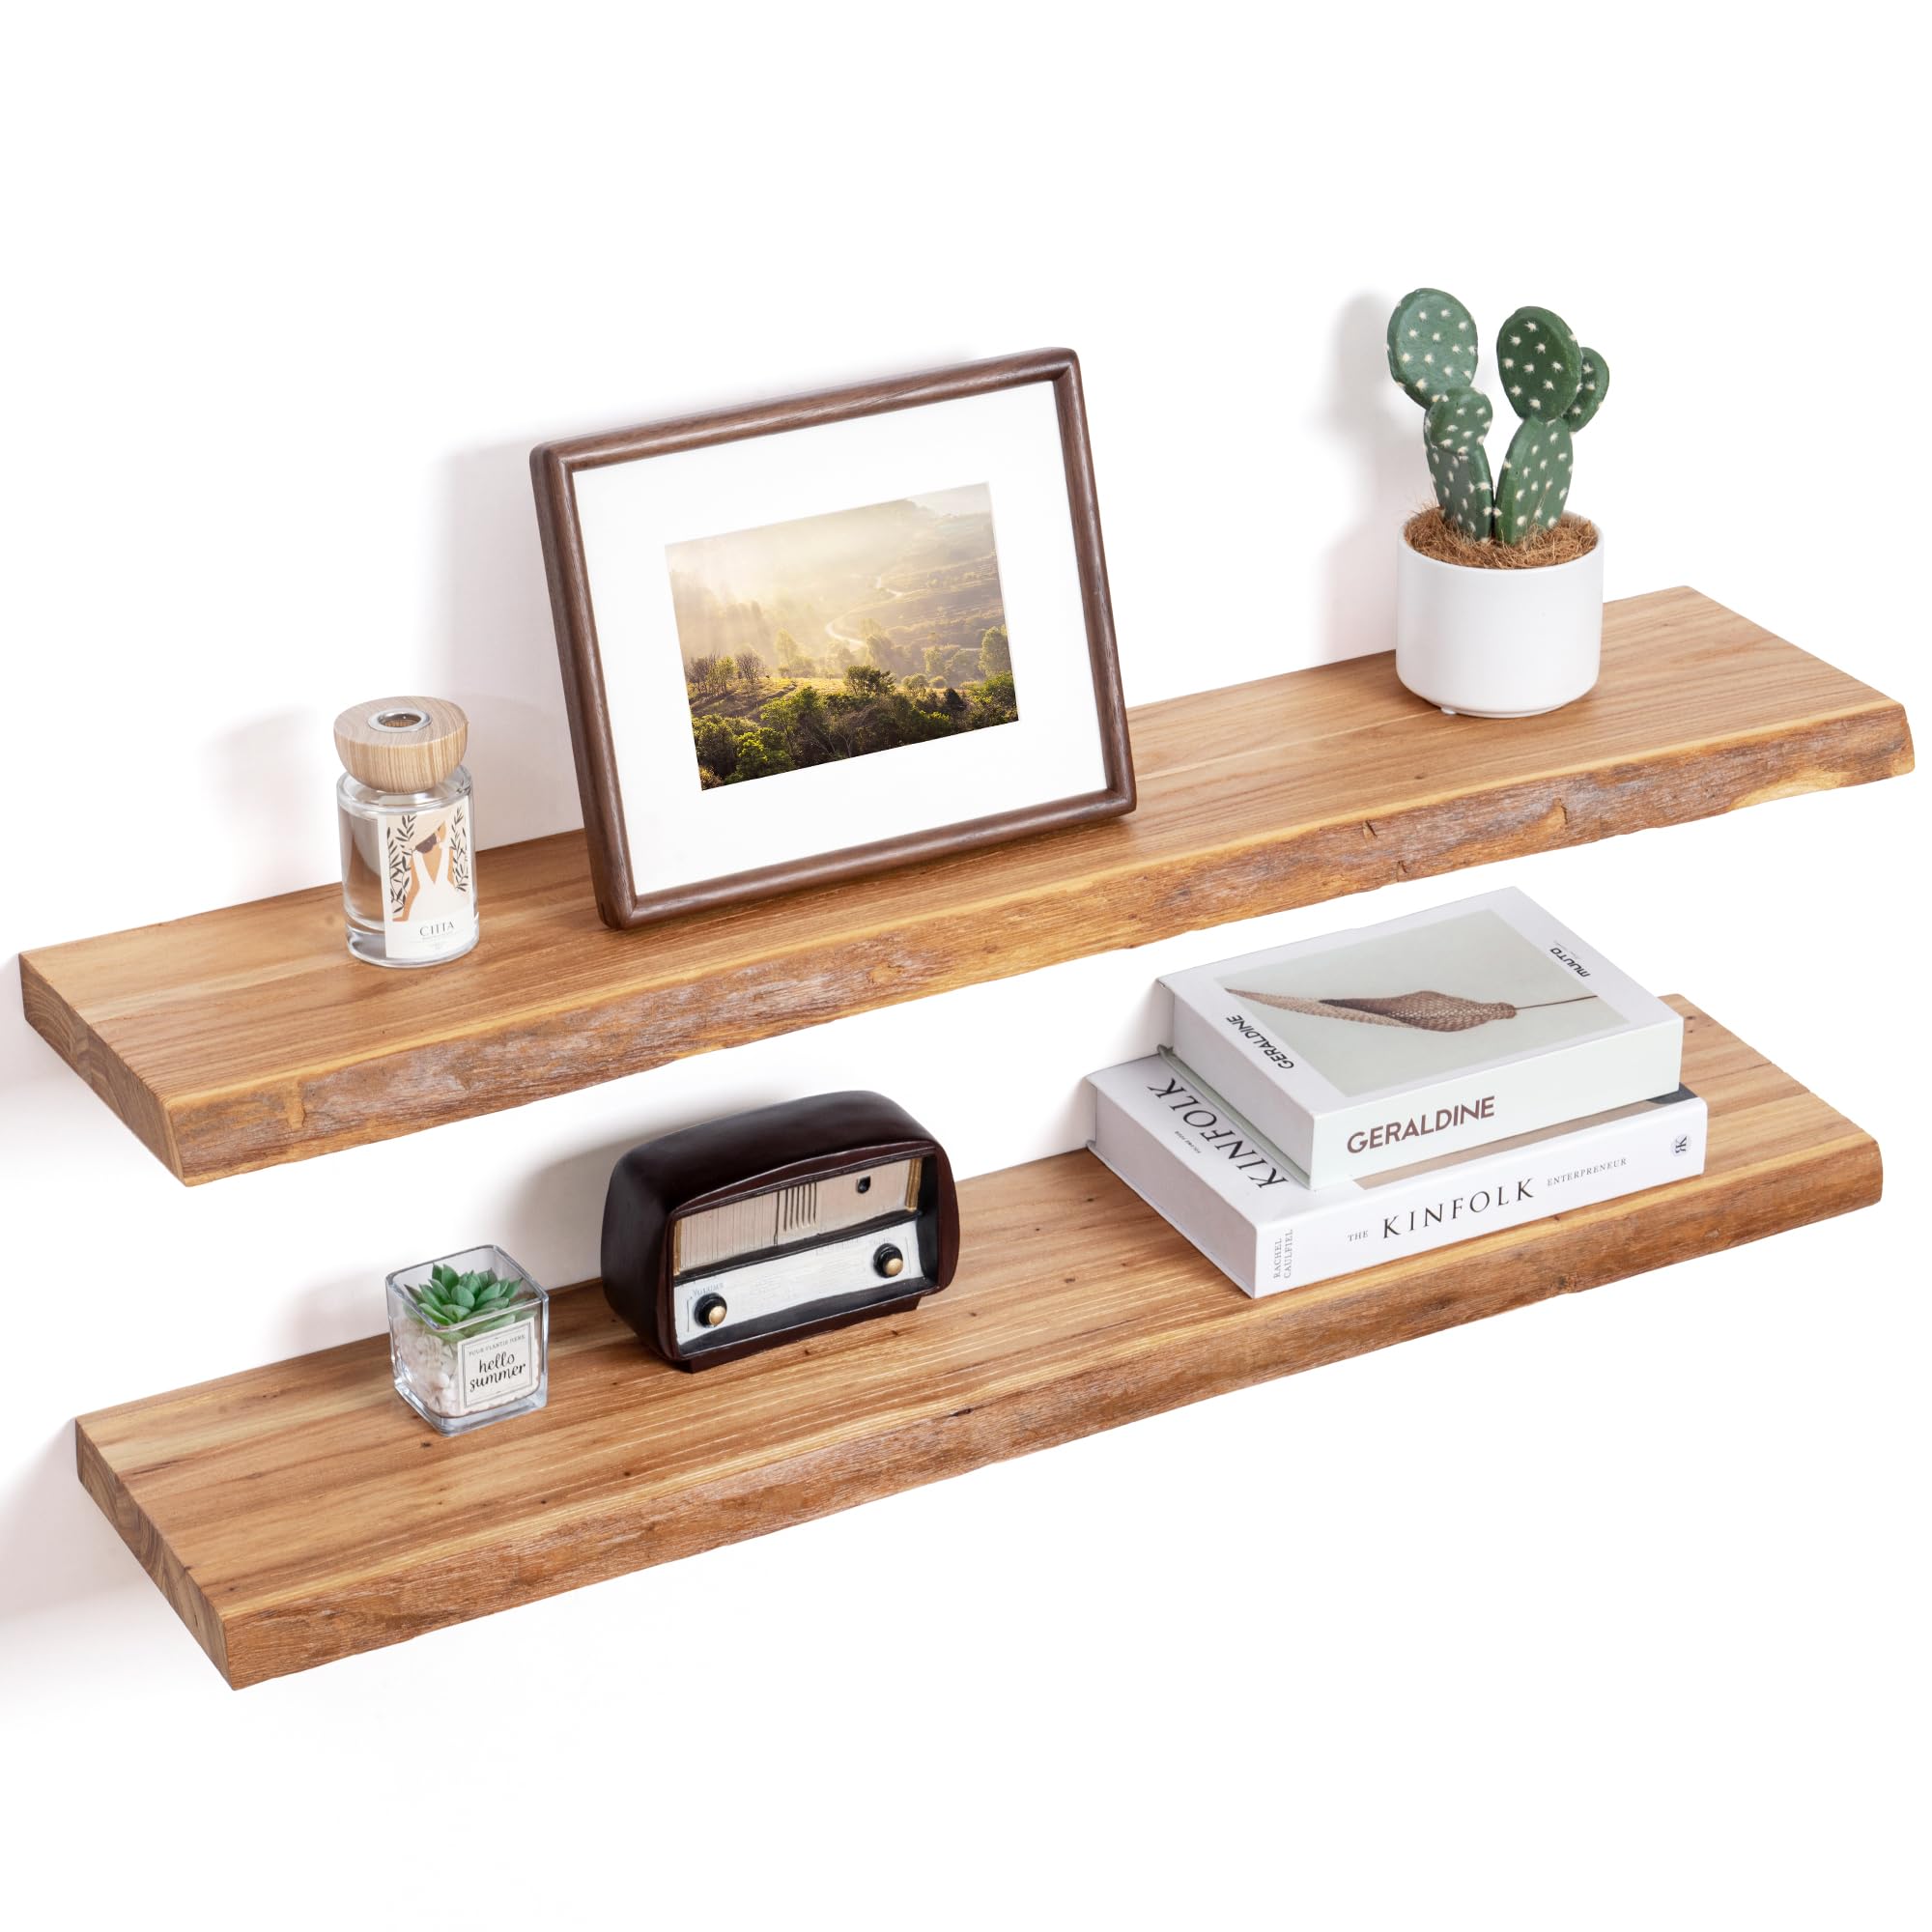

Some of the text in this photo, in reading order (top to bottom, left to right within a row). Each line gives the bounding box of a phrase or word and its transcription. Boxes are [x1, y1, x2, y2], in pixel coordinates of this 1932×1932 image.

[1225, 1014, 1294, 1069] GERALDINE
[1147, 1077, 1289, 1188] KINFOLK
[1347, 1095, 1495, 1153] GERALDINE
[1348, 1157, 1627, 1242] THE KINFOLK ENTERPRENEUR
[1273, 1237, 1283, 1279] RACHEL
[469, 1363, 526, 1392] summer
[479, 1351, 515, 1374] hello
